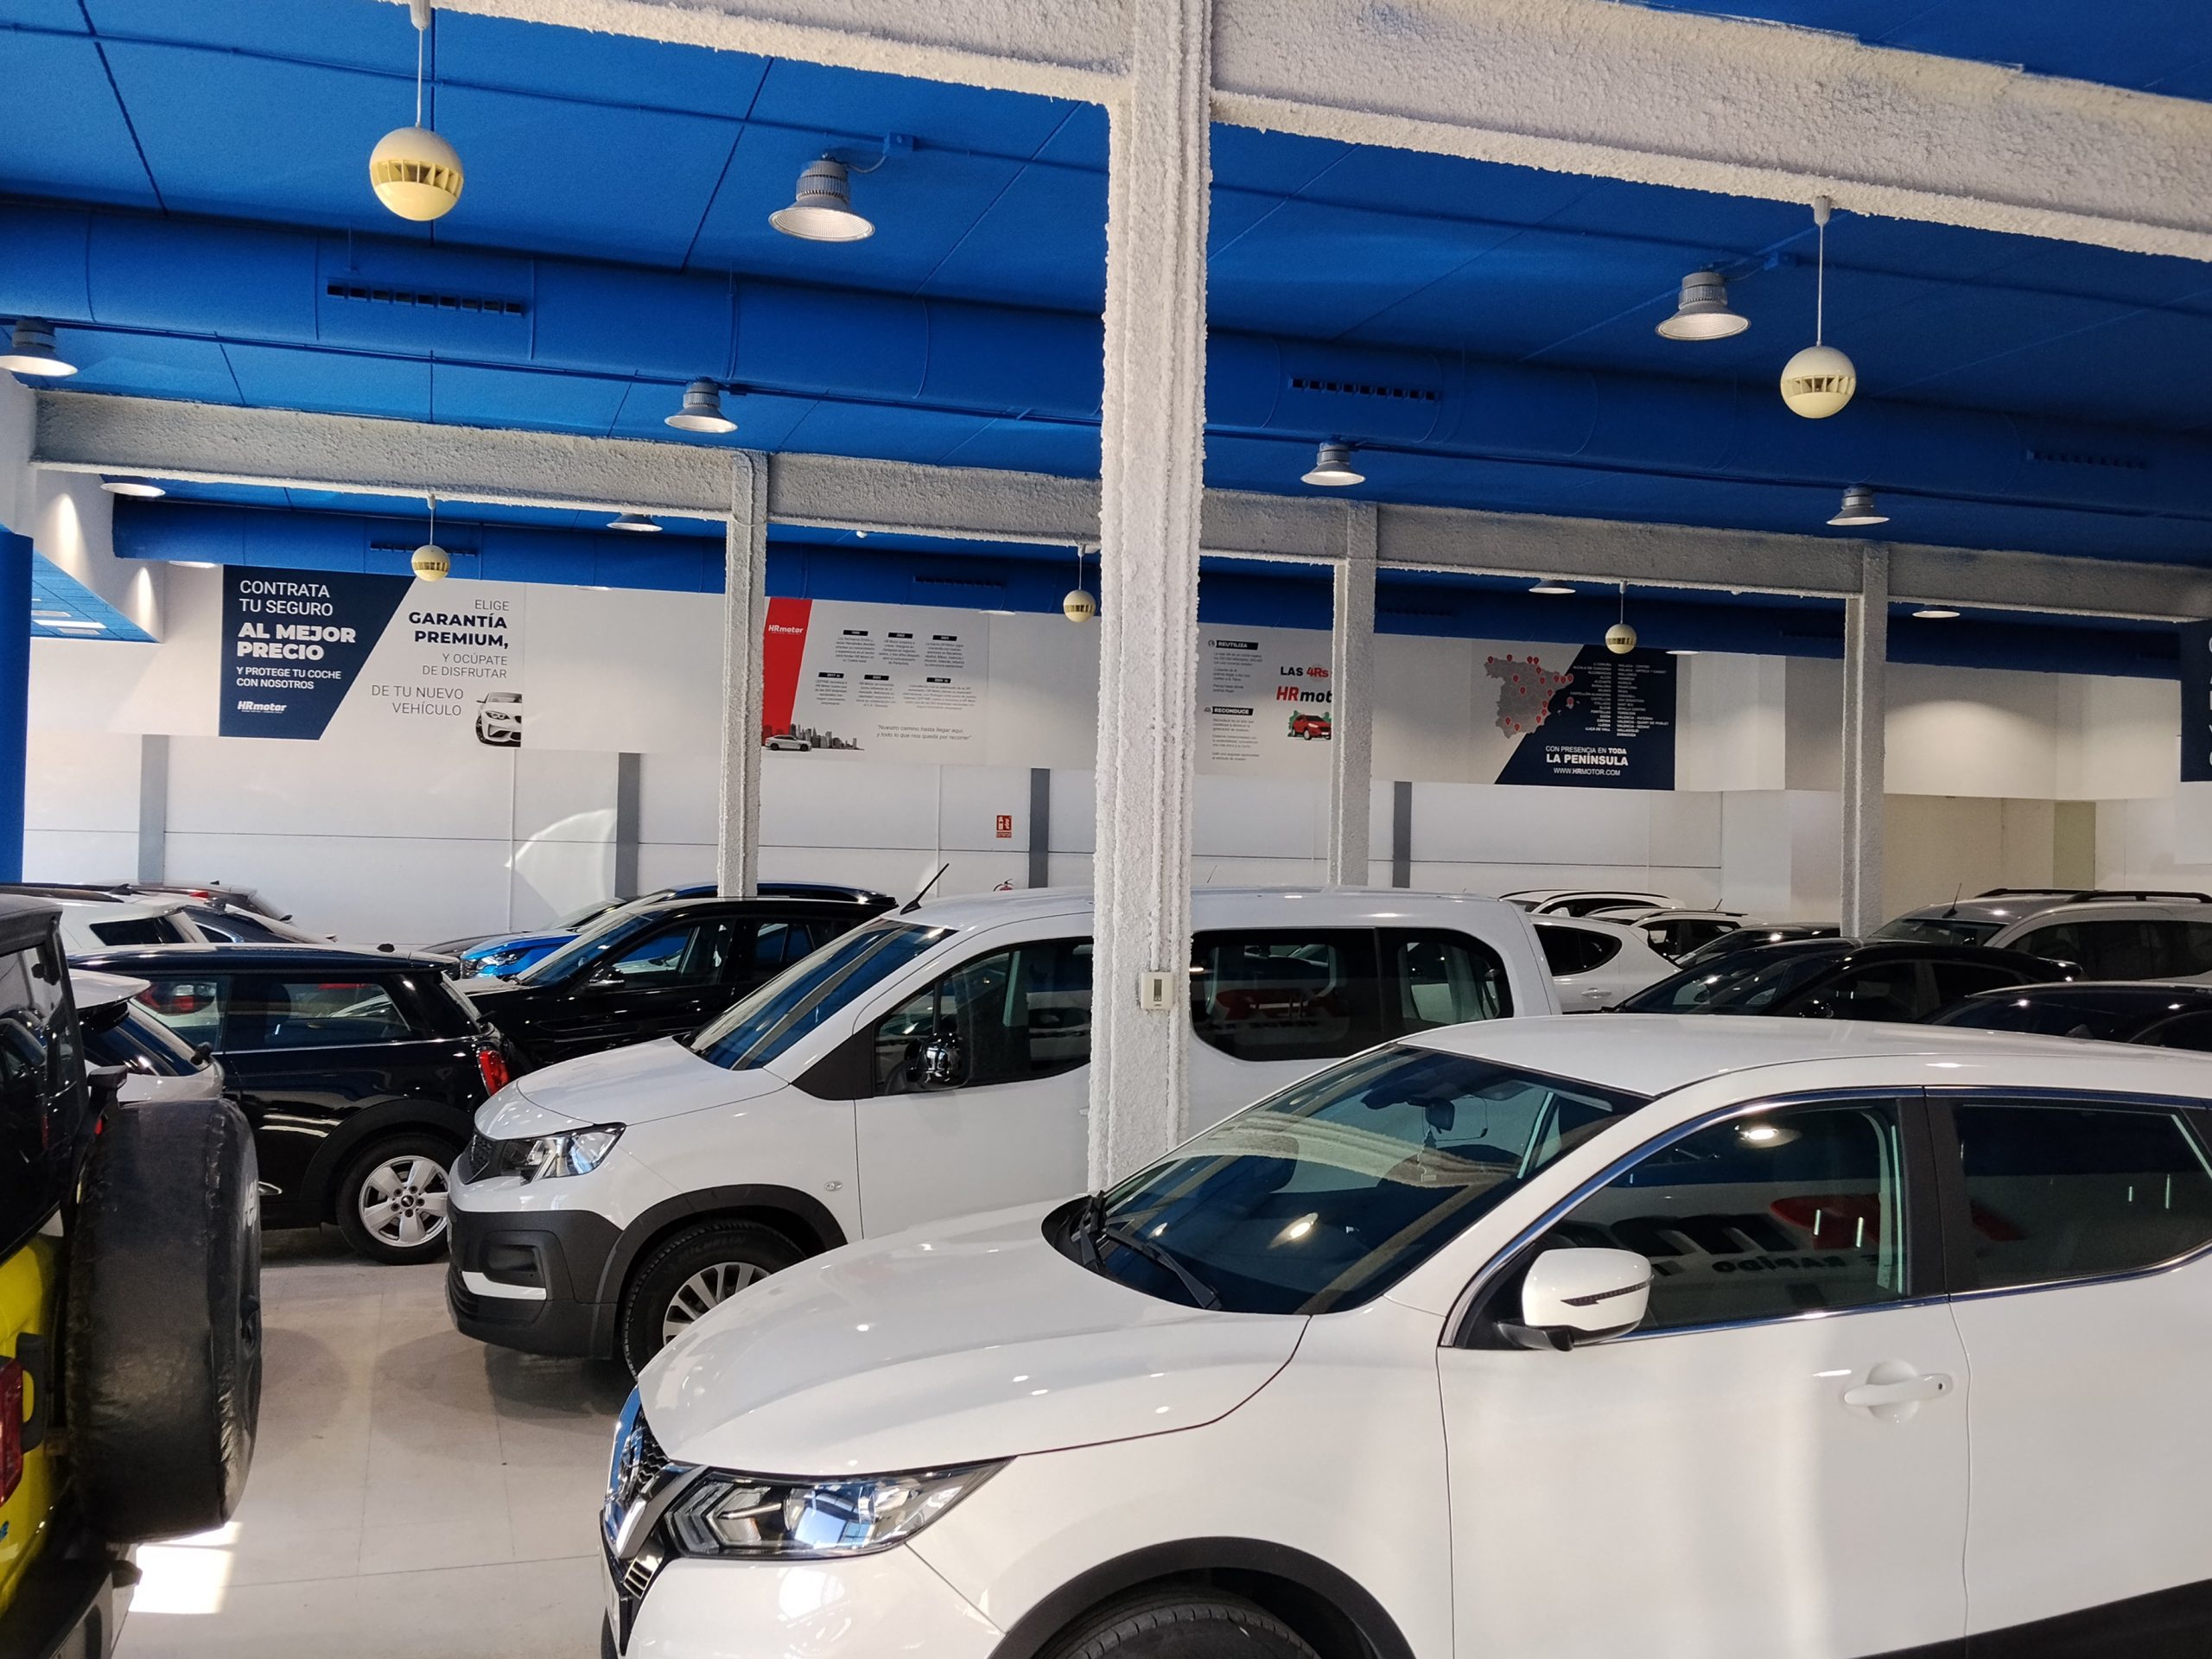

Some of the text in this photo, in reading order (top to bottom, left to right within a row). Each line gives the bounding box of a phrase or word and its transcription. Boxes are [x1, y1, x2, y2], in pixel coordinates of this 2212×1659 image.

[239, 580, 330, 598] CONTRATA
[239, 598, 334, 617] TU SEGURO
[474, 599, 509, 612] ELIGE
[409, 611, 508, 629] GARANTÍA
[238, 622, 356, 644] AL MEJOR
[768, 625, 804, 634] HRmotor
[414, 630, 509, 650] PREMIUM,
[237, 641, 324, 661] PRECIO
[442, 652, 508, 666] Y OCÚPATE
[236, 666, 342, 680] Y PROTEGE TU COCHE
[422, 665, 507, 678] DE DISFRUTAR
[1281, 666, 1329, 678] LAS 4Rs
[236, 677, 315, 690] CON NOSOTROS
[372, 684, 464, 700] DE TU NUEVO
[1275, 686, 1332, 703] HRmot
[237, 700, 287, 712] HRmotor
[391, 701, 462, 716] VEHÍCULO
[1560, 746, 1597, 754] PRESENCIA
[1546, 753, 1629, 766] LA PENÍNSULA
[1554, 767, 1621, 776] WWW.HRMOTOR.COM
